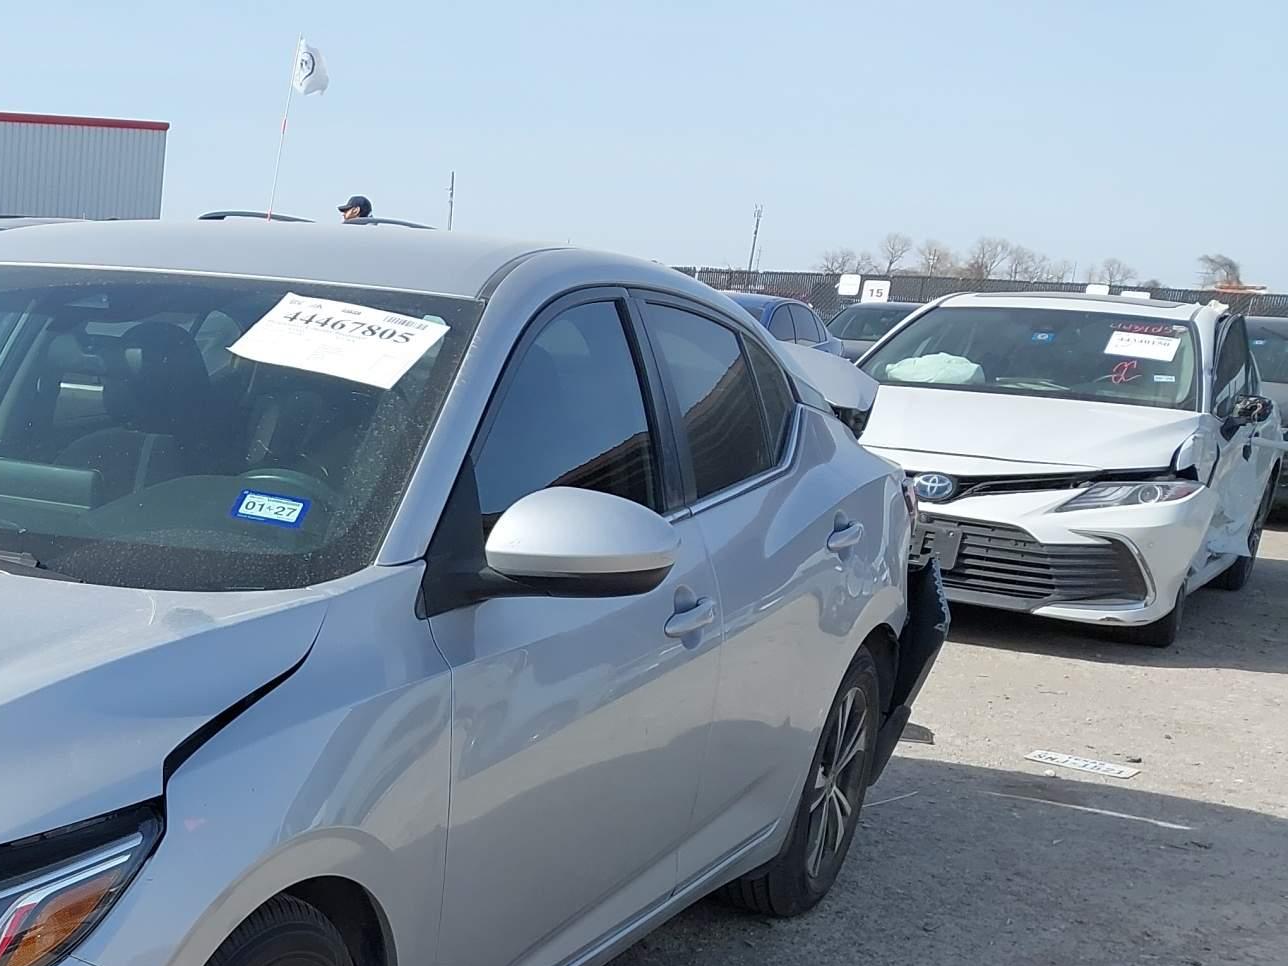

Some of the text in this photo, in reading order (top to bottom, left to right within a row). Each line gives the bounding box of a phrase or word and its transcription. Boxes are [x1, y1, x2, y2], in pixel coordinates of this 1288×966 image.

[869, 288, 884, 298] 15
[283, 311, 415, 344] 44467805
[244, 500, 265, 513] 01
[273, 505, 298, 517] 27
